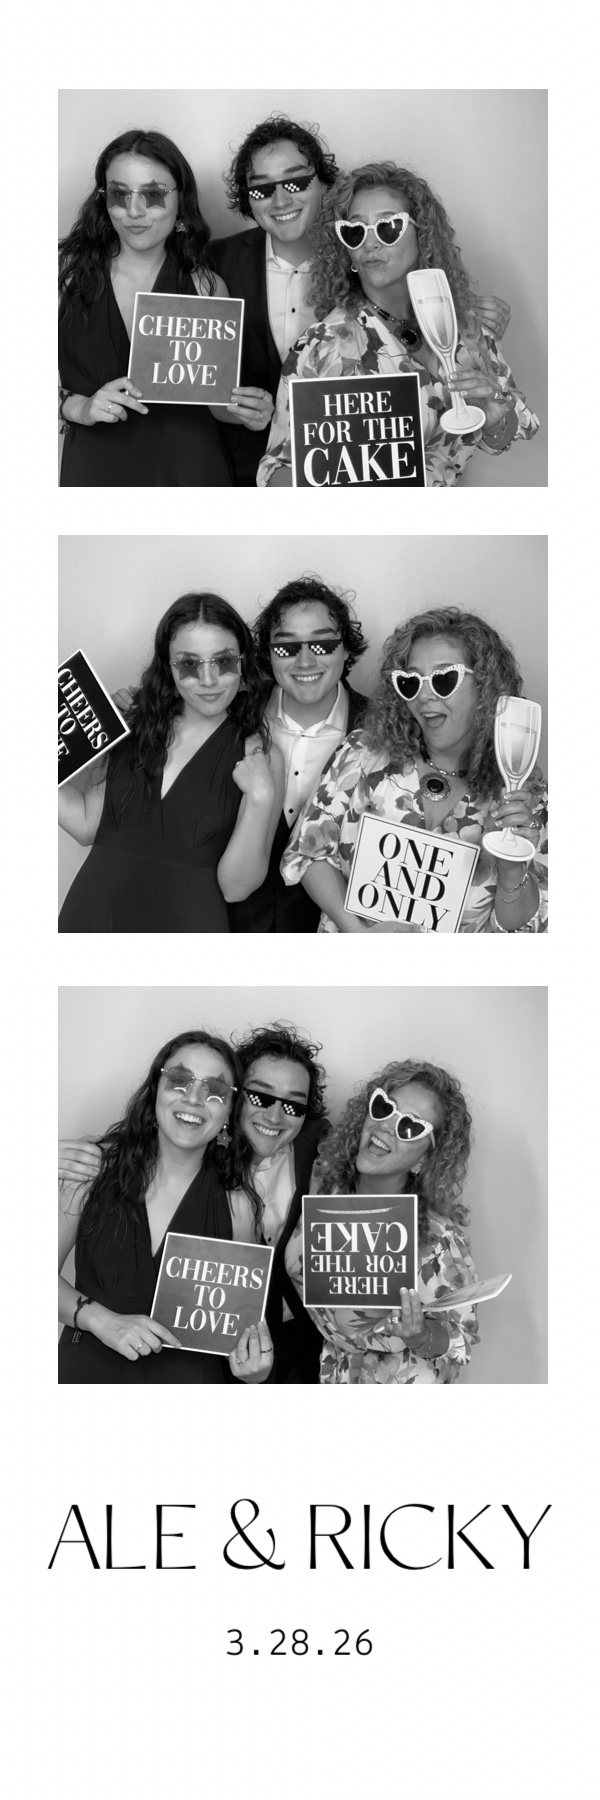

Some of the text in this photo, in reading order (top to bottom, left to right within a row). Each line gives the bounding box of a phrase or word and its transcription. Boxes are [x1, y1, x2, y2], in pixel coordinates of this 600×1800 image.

[138, 314, 237, 341] CHEERS
[169, 340, 202, 362] TO
[151, 362, 217, 386] LOVE
[323, 390, 392, 417] HERE
[303, 416, 414, 446] FOR THE
[303, 440, 417, 487] CAKE
[58, 668, 109, 750] CHEERS
[378, 832, 454, 878] ONE
[371, 860, 446, 901] AND
[358, 883, 451, 932] ONLY
[310, 1221, 409, 1254] CAKE
[165, 1256, 264, 1290] CHEERS
[310, 1254, 407, 1274] FOR THE
[193, 1284, 226, 1309] TO
[329, 1276, 389, 1295] HERE
[172, 1305, 240, 1337] LOVE
